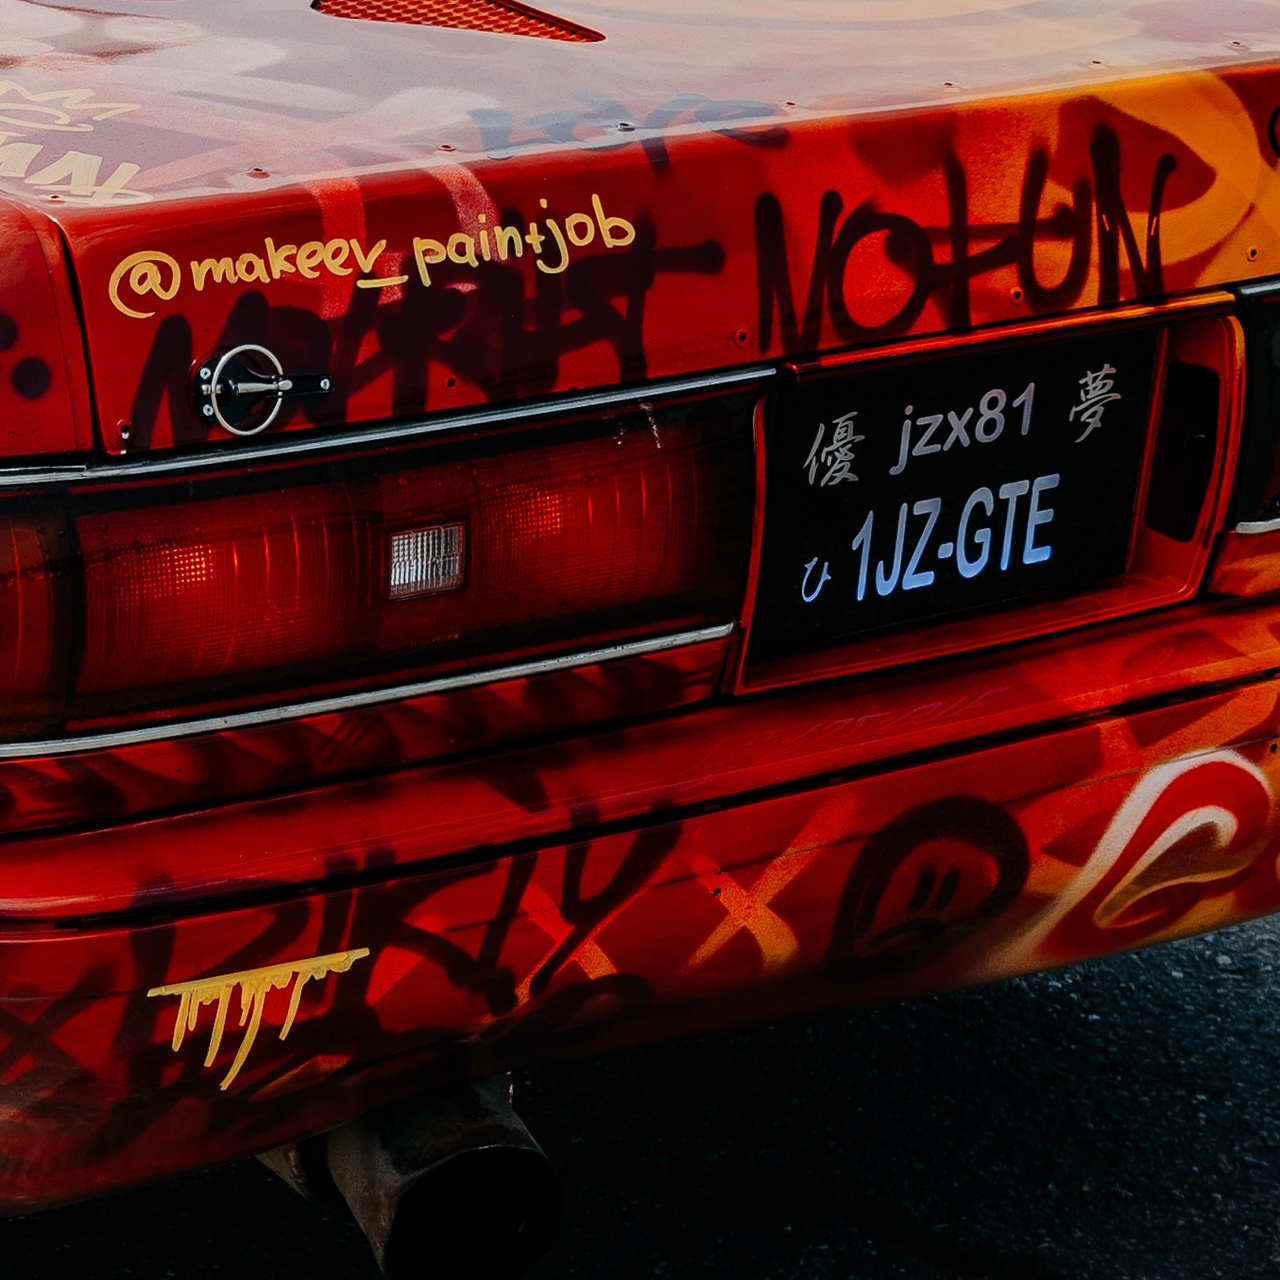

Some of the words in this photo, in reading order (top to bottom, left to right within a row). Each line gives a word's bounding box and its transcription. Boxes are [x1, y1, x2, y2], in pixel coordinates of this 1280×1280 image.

[108, 193, 636, 319] @makeev_paintjob
[889, 382, 1035, 476] jzx81
[851, 473, 1060, 602] 1JZ-GTE
